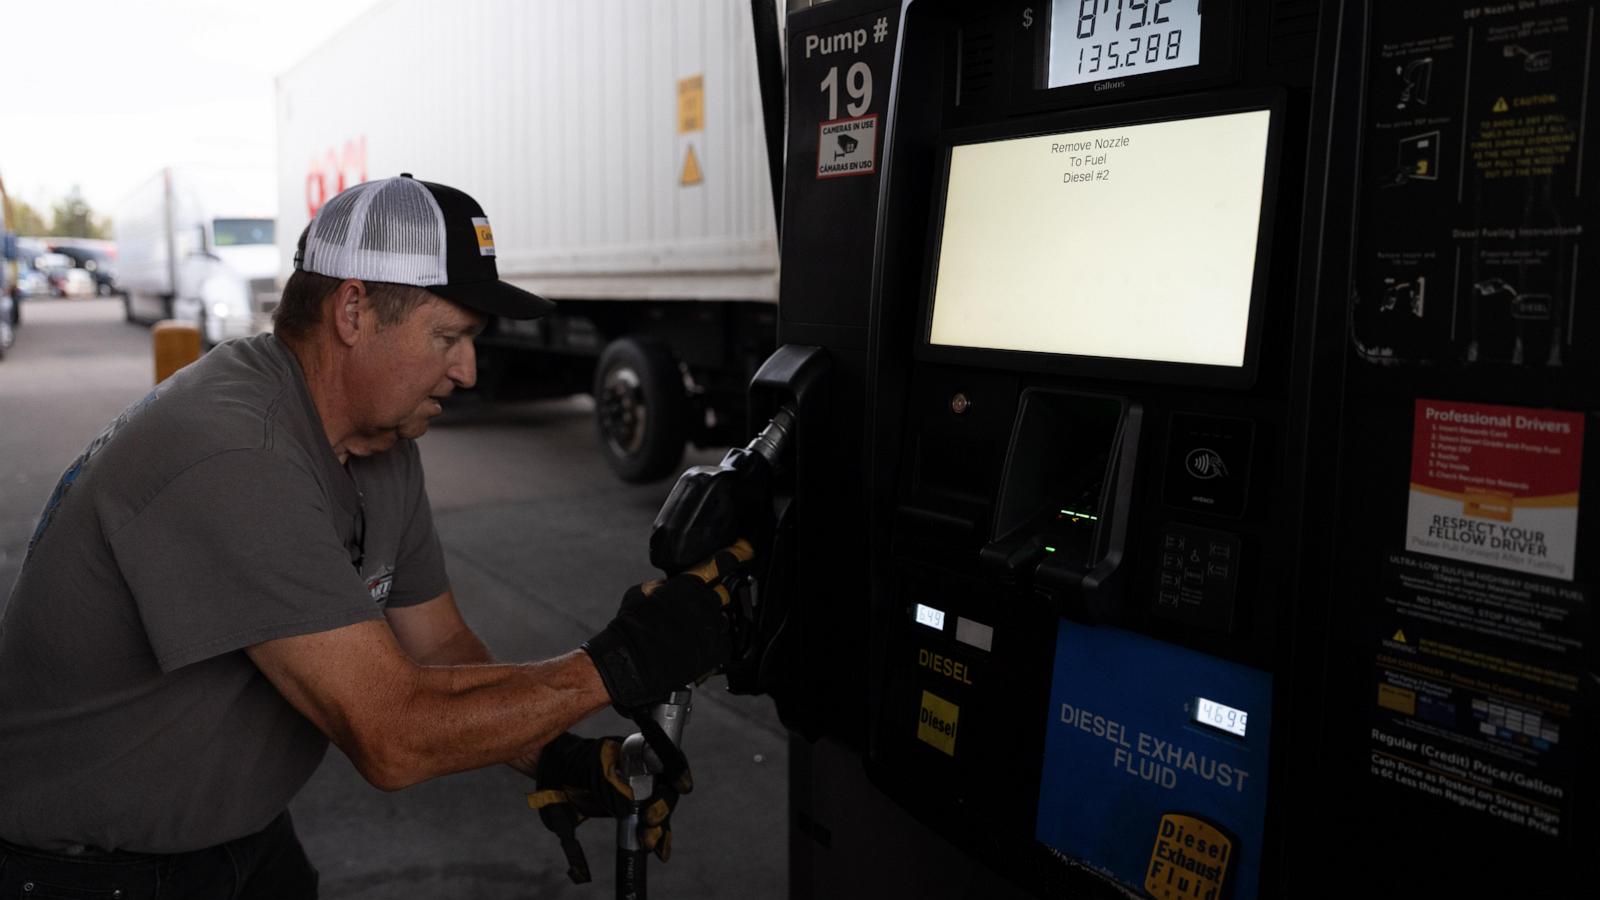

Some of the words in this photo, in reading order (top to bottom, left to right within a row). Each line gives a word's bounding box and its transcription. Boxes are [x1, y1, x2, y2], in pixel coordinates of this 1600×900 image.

[805, 26, 868, 59] Pump
[873, 16, 888, 45] #
[1076, 0, 1200, 39] 879.2
[1078, 30, 1182, 75] 135.288
[820, 61, 873, 121] 19
[1093, 80, 1126, 92] Gallons
[822, 122, 852, 135] CAMERAS
[853, 122, 860, 131] IN
[861, 119, 874, 130] USE
[1051, 141, 1092, 154] Remove
[1094, 135, 1131, 150] Nozzle
[819, 161, 849, 174] CÁMARAS
[849, 161, 859, 171] EN
[859, 159, 873, 170] USO
[1063, 170, 1094, 184] Diesel
[1096, 169, 1110, 181] #2
[1070, 156, 1082, 167] To
[1084, 153, 1107, 167] Fuel
[1425, 407, 1512, 429] Professional
[1515, 415, 1571, 434] Drivers
[1428, 526, 1487, 546] FELLOW
[1490, 537, 1548, 558] DRIVER
[1432, 514, 1495, 535] RESPECT
[1500, 526, 1545, 543] YOUR
[918, 647, 973, 686] DIESEL
[920, 707, 956, 738] Diesel
[1060, 703, 1131, 749] DIESEL
[1137, 732, 1250, 793] EXHAUST
[1371, 728, 1418, 752] Regular
[1420, 743, 1470, 769] (Credit)
[1472, 759, 1564, 799] Price/Gallon
[1113, 747, 1177, 790] FLUID
[1371, 752, 1396, 770] Cash
[1397, 760, 1424, 778] Price
[1424, 771, 1437, 783] as
[1439, 775, 1476, 796] Posted
[1477, 789, 1493, 802] on
[1494, 793, 1530, 815] Street
[1533, 804, 1561, 825] Sign
[1371, 764, 1379, 776] is
[1395, 771, 1418, 789] Less
[1418, 779, 1443, 797] than
[1444, 788, 1487, 811] Regular
[1488, 803, 1524, 825] Credit
[1527, 817, 1559, 838] Price
[1161, 819, 1229, 864] Diesel
[1151, 860, 1217, 900] Fluid
[1156, 839, 1222, 884] Exhaust
